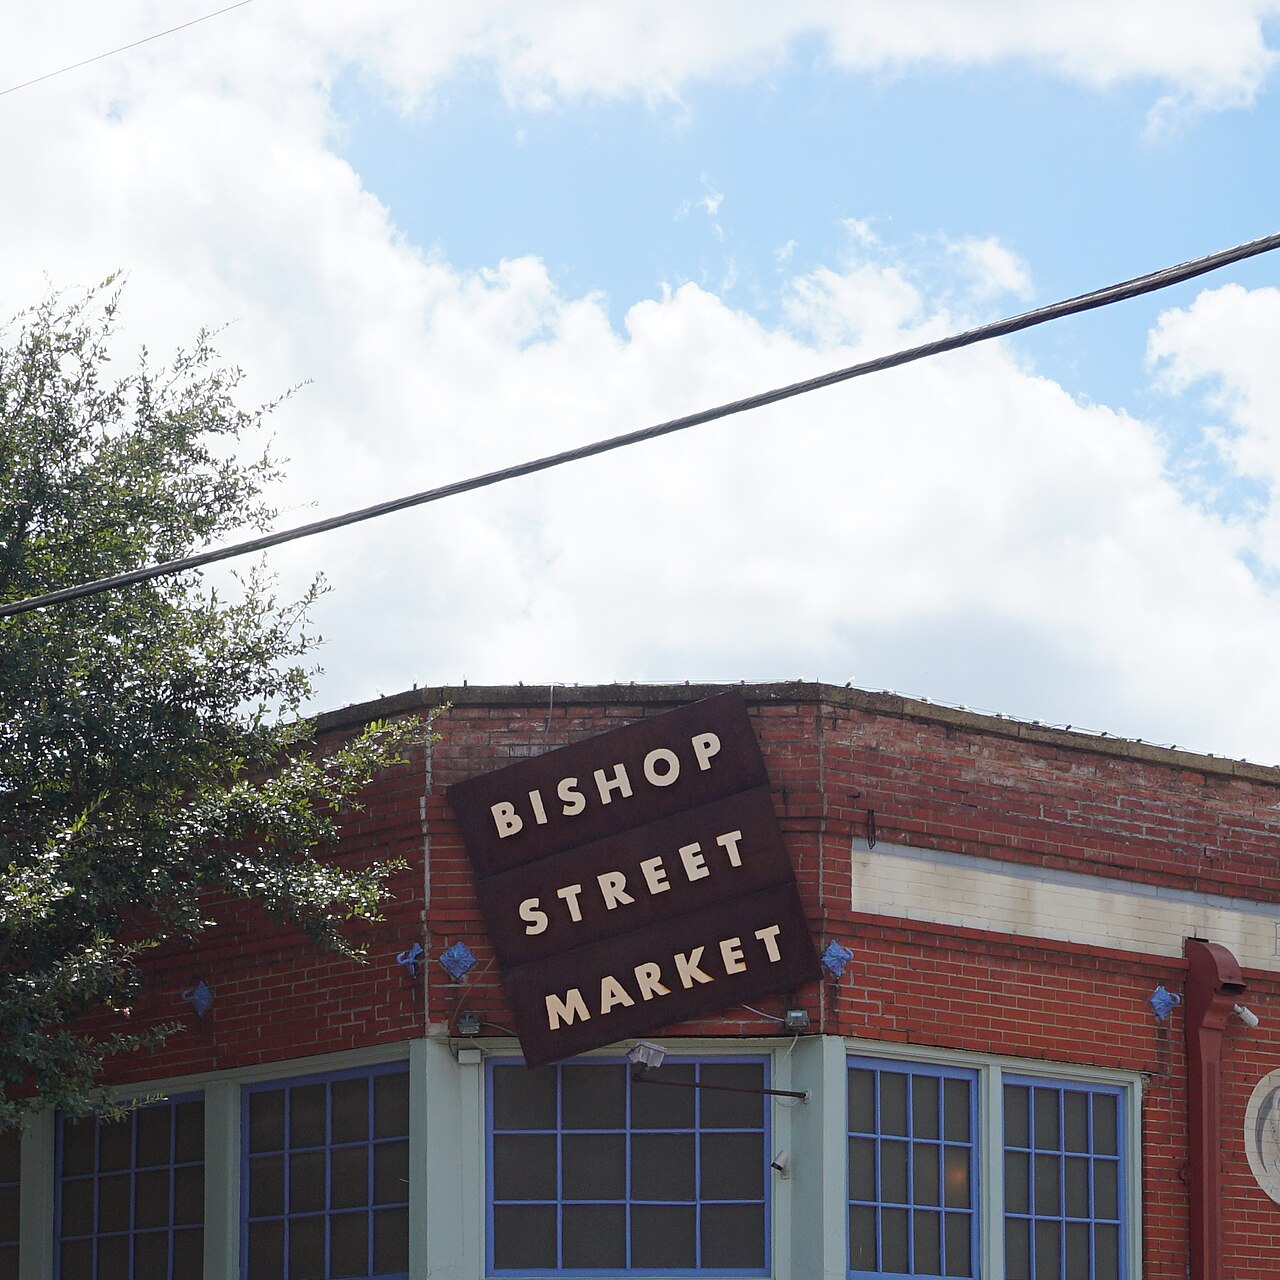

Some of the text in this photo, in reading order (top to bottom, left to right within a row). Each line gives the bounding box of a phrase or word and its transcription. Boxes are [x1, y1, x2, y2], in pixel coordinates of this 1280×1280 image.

[490, 732, 721, 839] BISHOP
[518, 830, 744, 936] STREET
[544, 924, 781, 1030] MARKET
